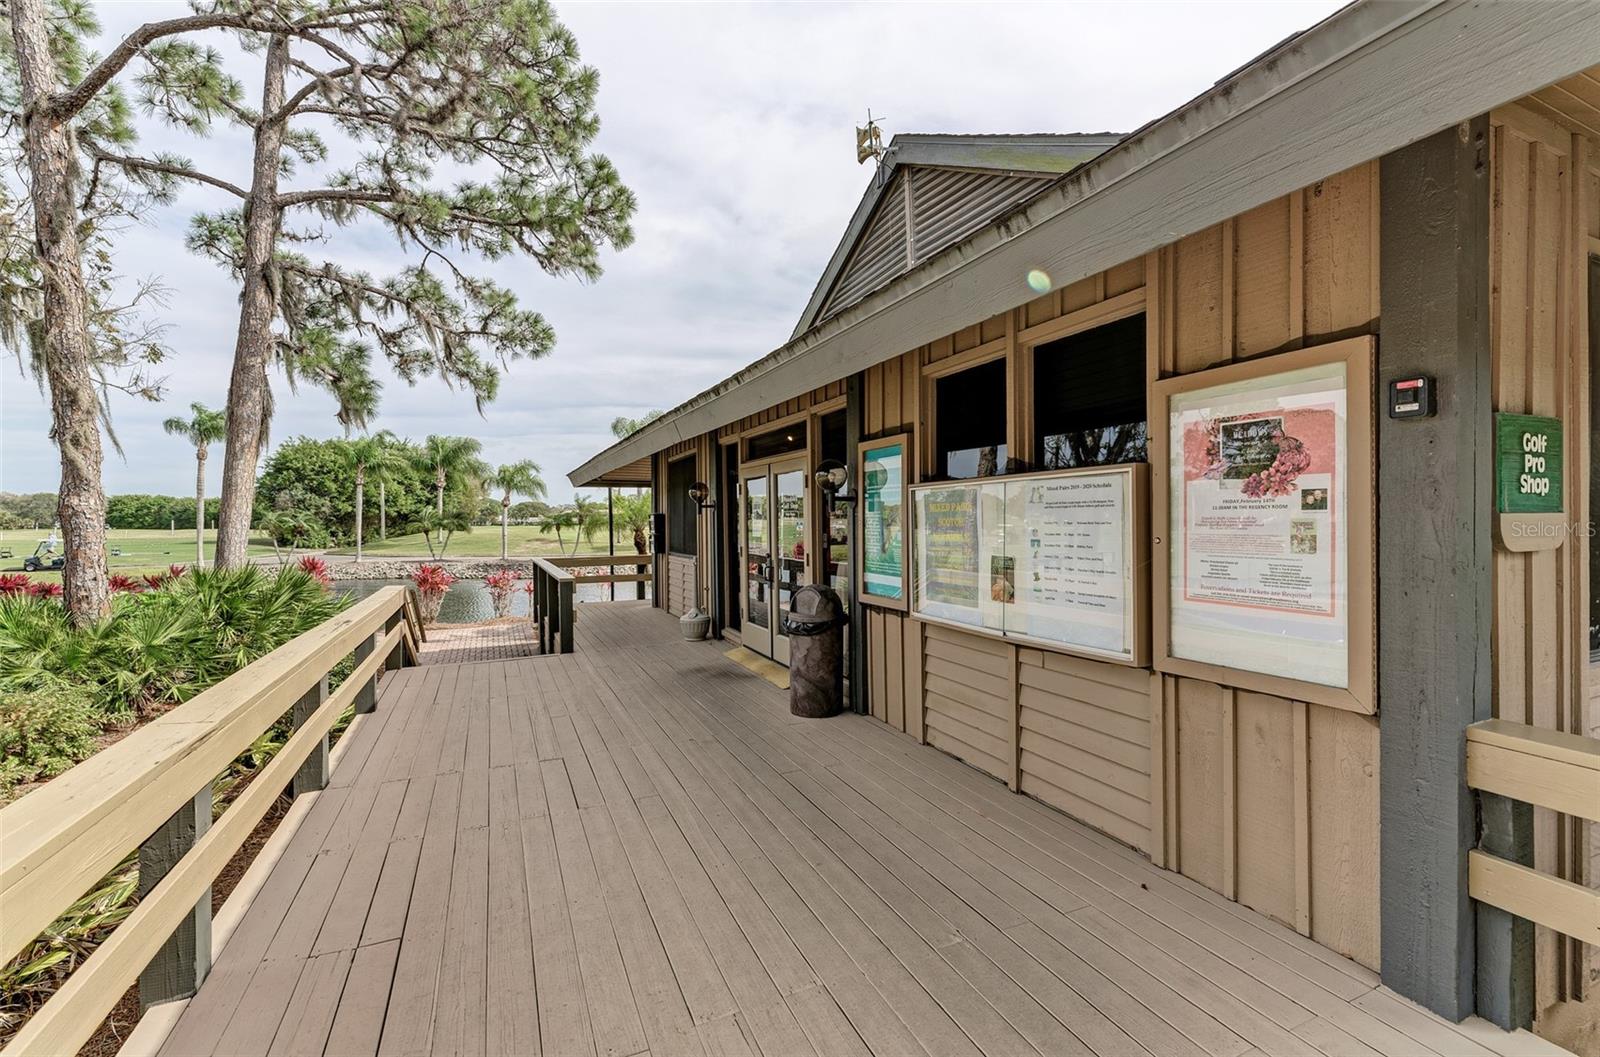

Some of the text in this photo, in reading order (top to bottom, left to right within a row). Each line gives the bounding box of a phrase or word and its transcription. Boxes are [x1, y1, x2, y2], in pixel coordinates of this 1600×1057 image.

[1523, 433, 1547, 453] Golf
[1524, 454, 1545, 473] Pro
[1520, 474, 1549, 496] Shop
[1248, 588, 1270, 596] Tickets
[1281, 591, 1312, 600] Required
